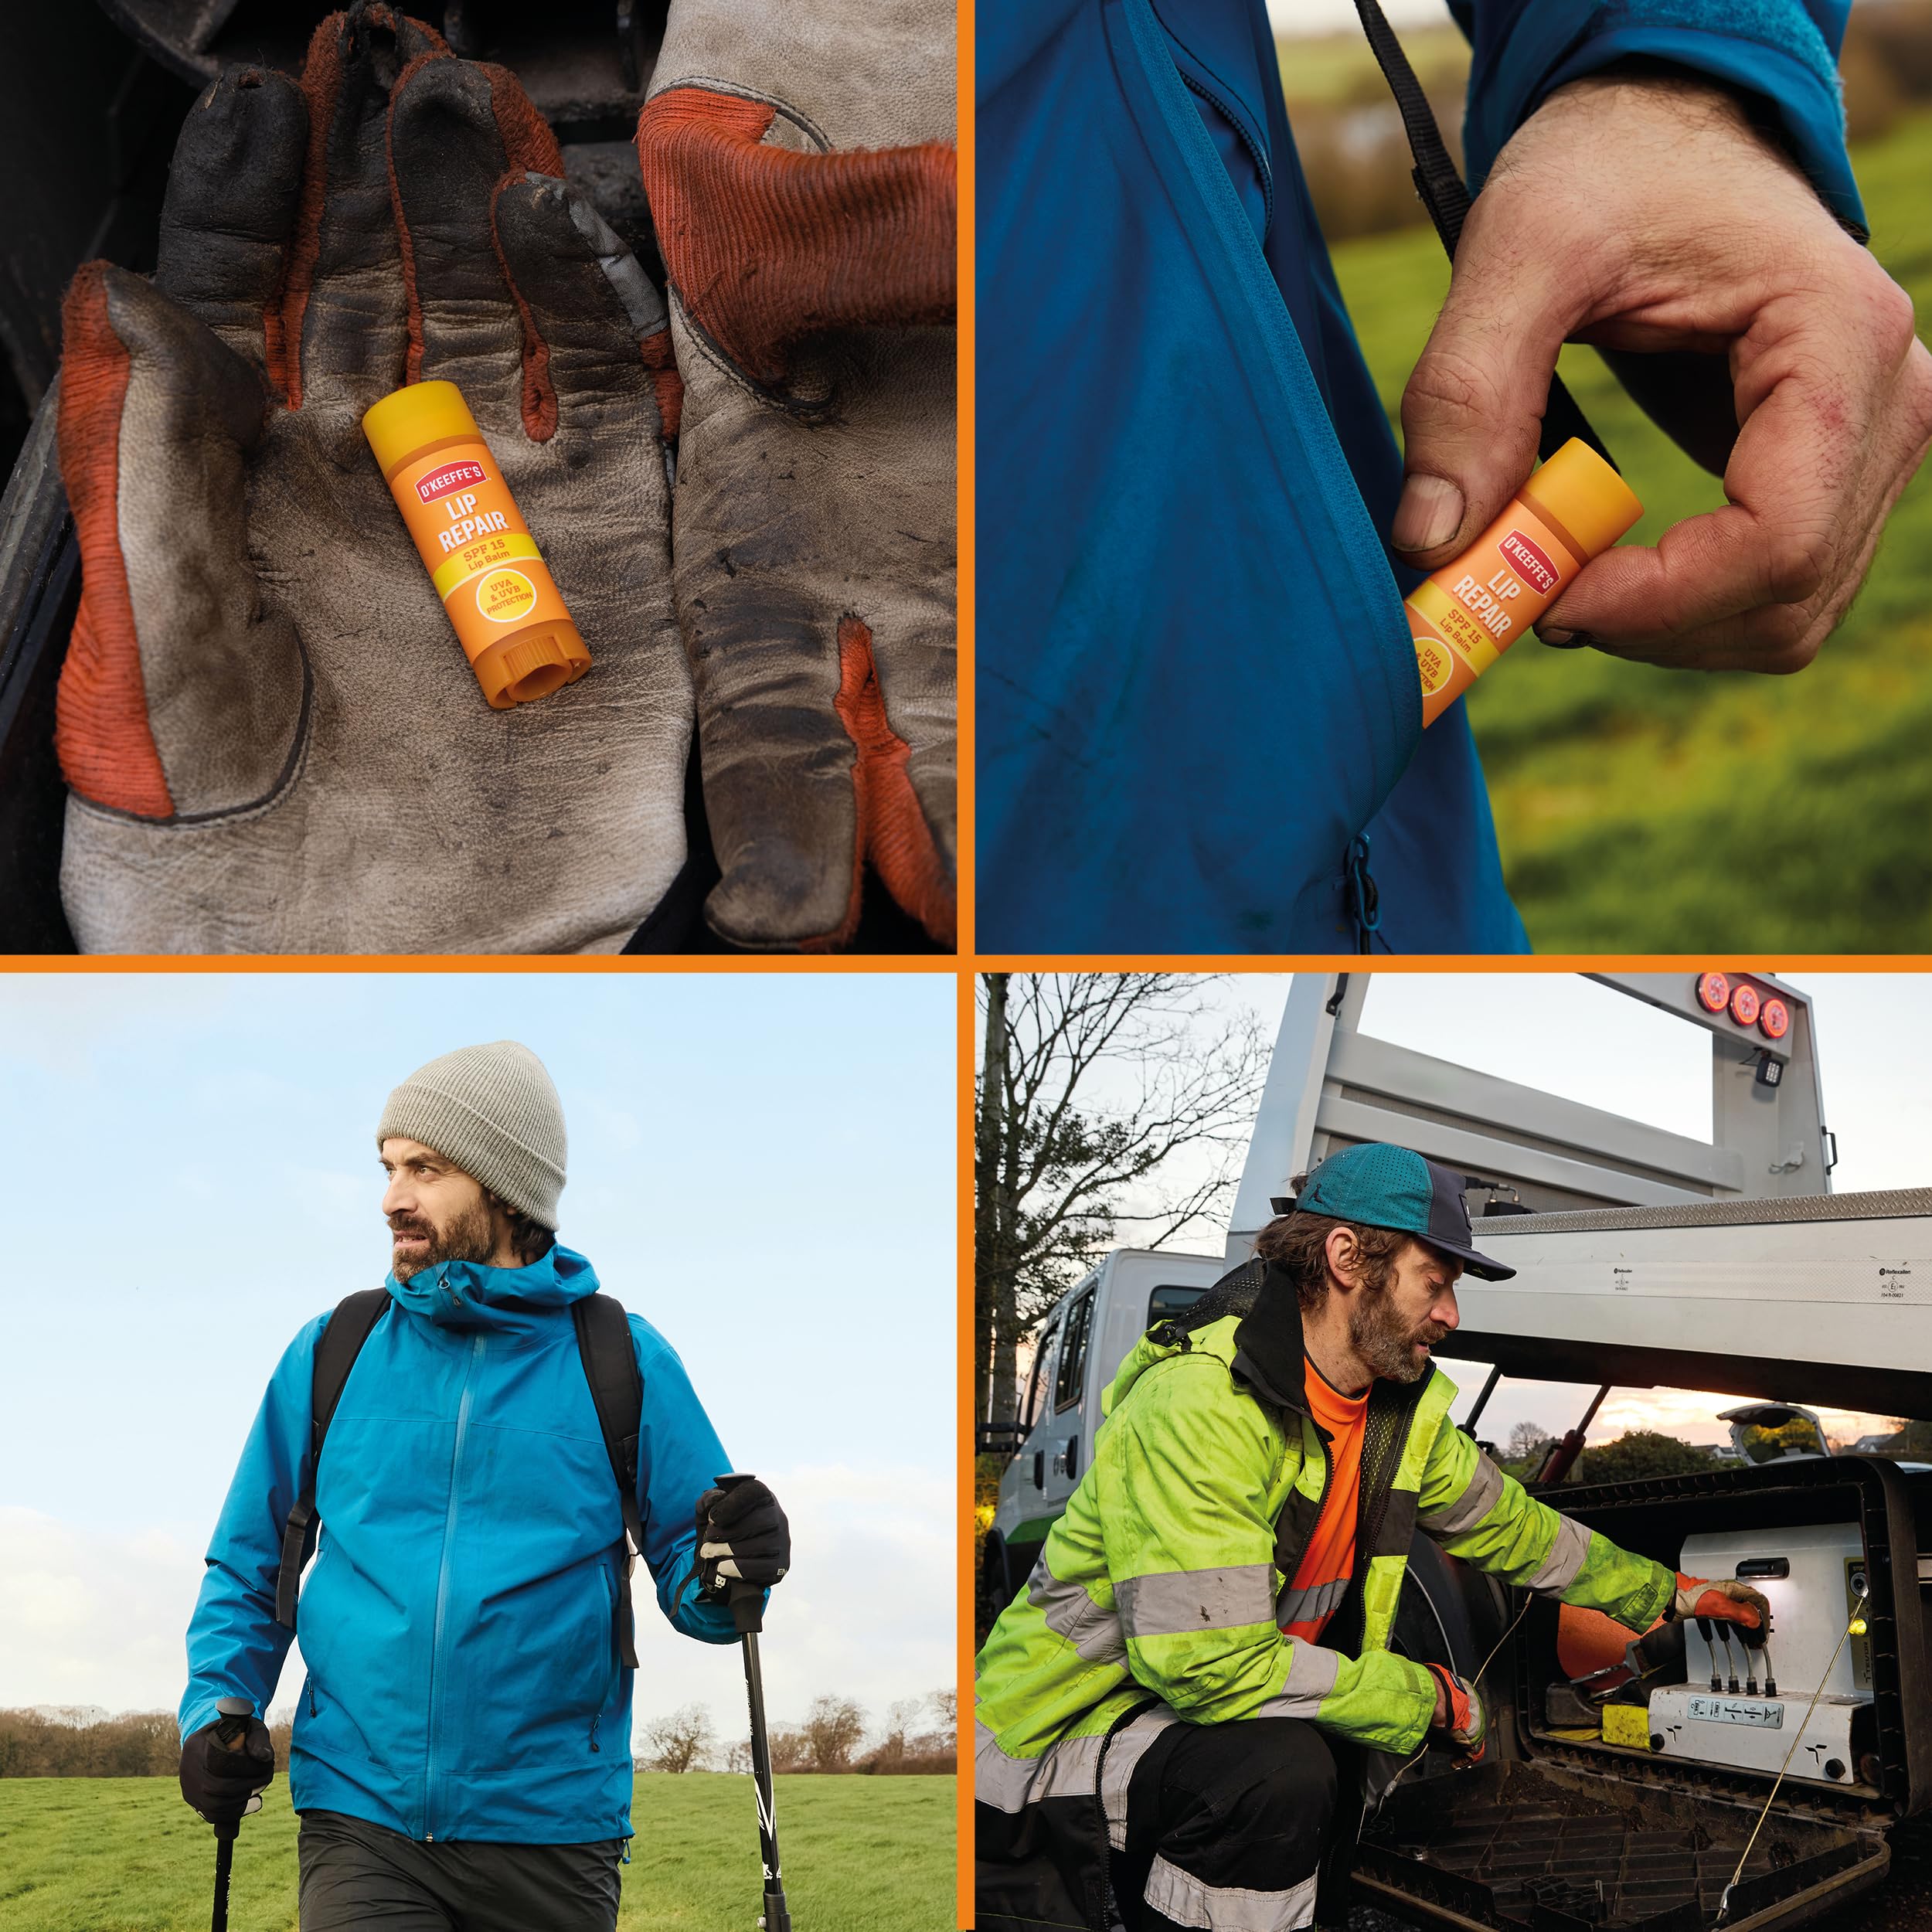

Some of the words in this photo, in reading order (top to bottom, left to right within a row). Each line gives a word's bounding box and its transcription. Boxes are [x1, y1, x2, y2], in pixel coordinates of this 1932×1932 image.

[420, 466, 482, 498] O'KEEFFE'S
[445, 493, 478, 521] LIP
[437, 510, 510, 553] REPAIR
[464, 543, 488, 563] SPF
[490, 539, 506, 550] 15
[468, 560, 484, 570] Lip
[485, 550, 510, 563] Balm
[1503, 536, 1554, 590] O'KEEFFE'S
[490, 579, 513, 591] UVA
[490, 594, 498, 602] &
[498, 585, 521, 598] UVB
[1487, 569, 1522, 601] LIP
[486, 592, 533, 614] PROTECTION
[1452, 574, 1513, 639] REPAIR
[1440, 617, 1453, 634] Lip
[1452, 630, 1471, 653] Balm
[1447, 608, 1471, 631] SPF
[1468, 630, 1482, 644] 15
[1420, 658, 1438, 679] UVB
[1424, 648, 1441, 668] UVA
